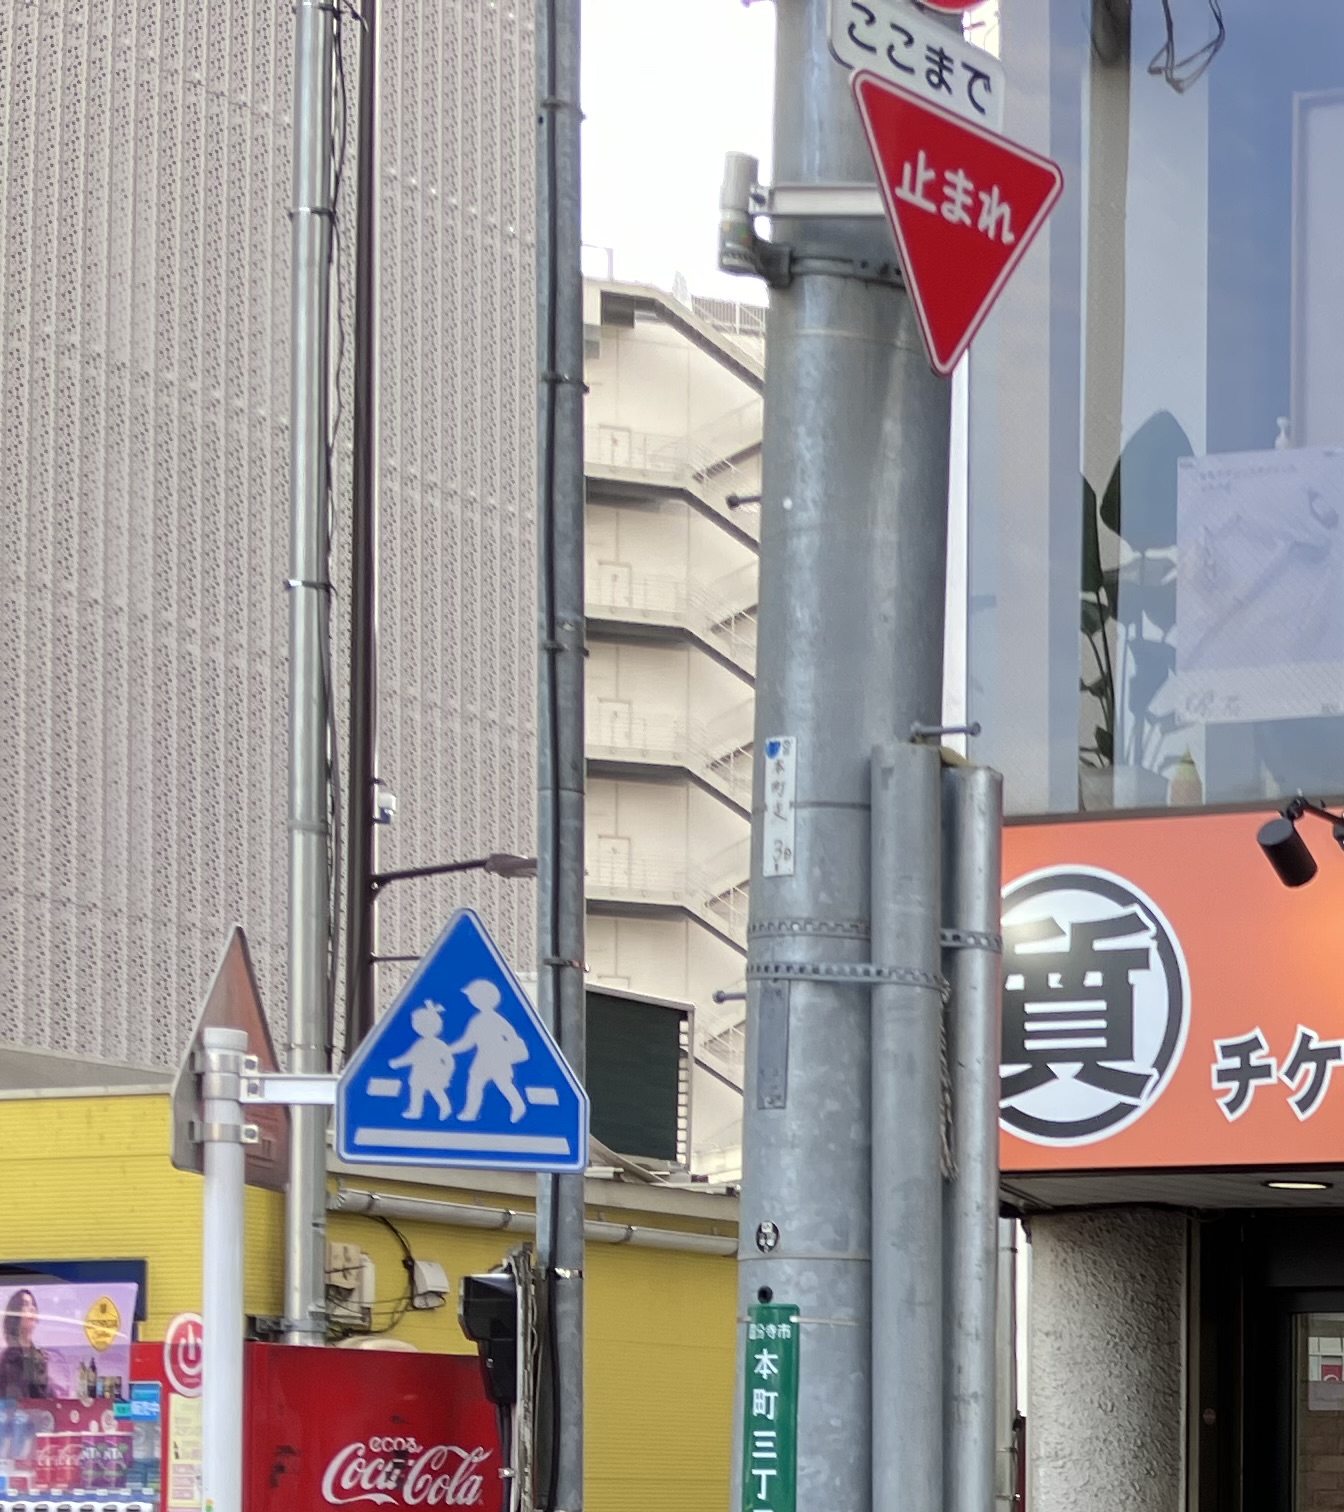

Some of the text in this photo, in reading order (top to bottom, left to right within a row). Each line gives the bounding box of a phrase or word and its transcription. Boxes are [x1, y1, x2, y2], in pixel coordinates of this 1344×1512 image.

[847, 1, 993, 115] ここまで
[895, 149, 1014, 246] 止まれ
[1000, 906, 1158, 1101] 質
